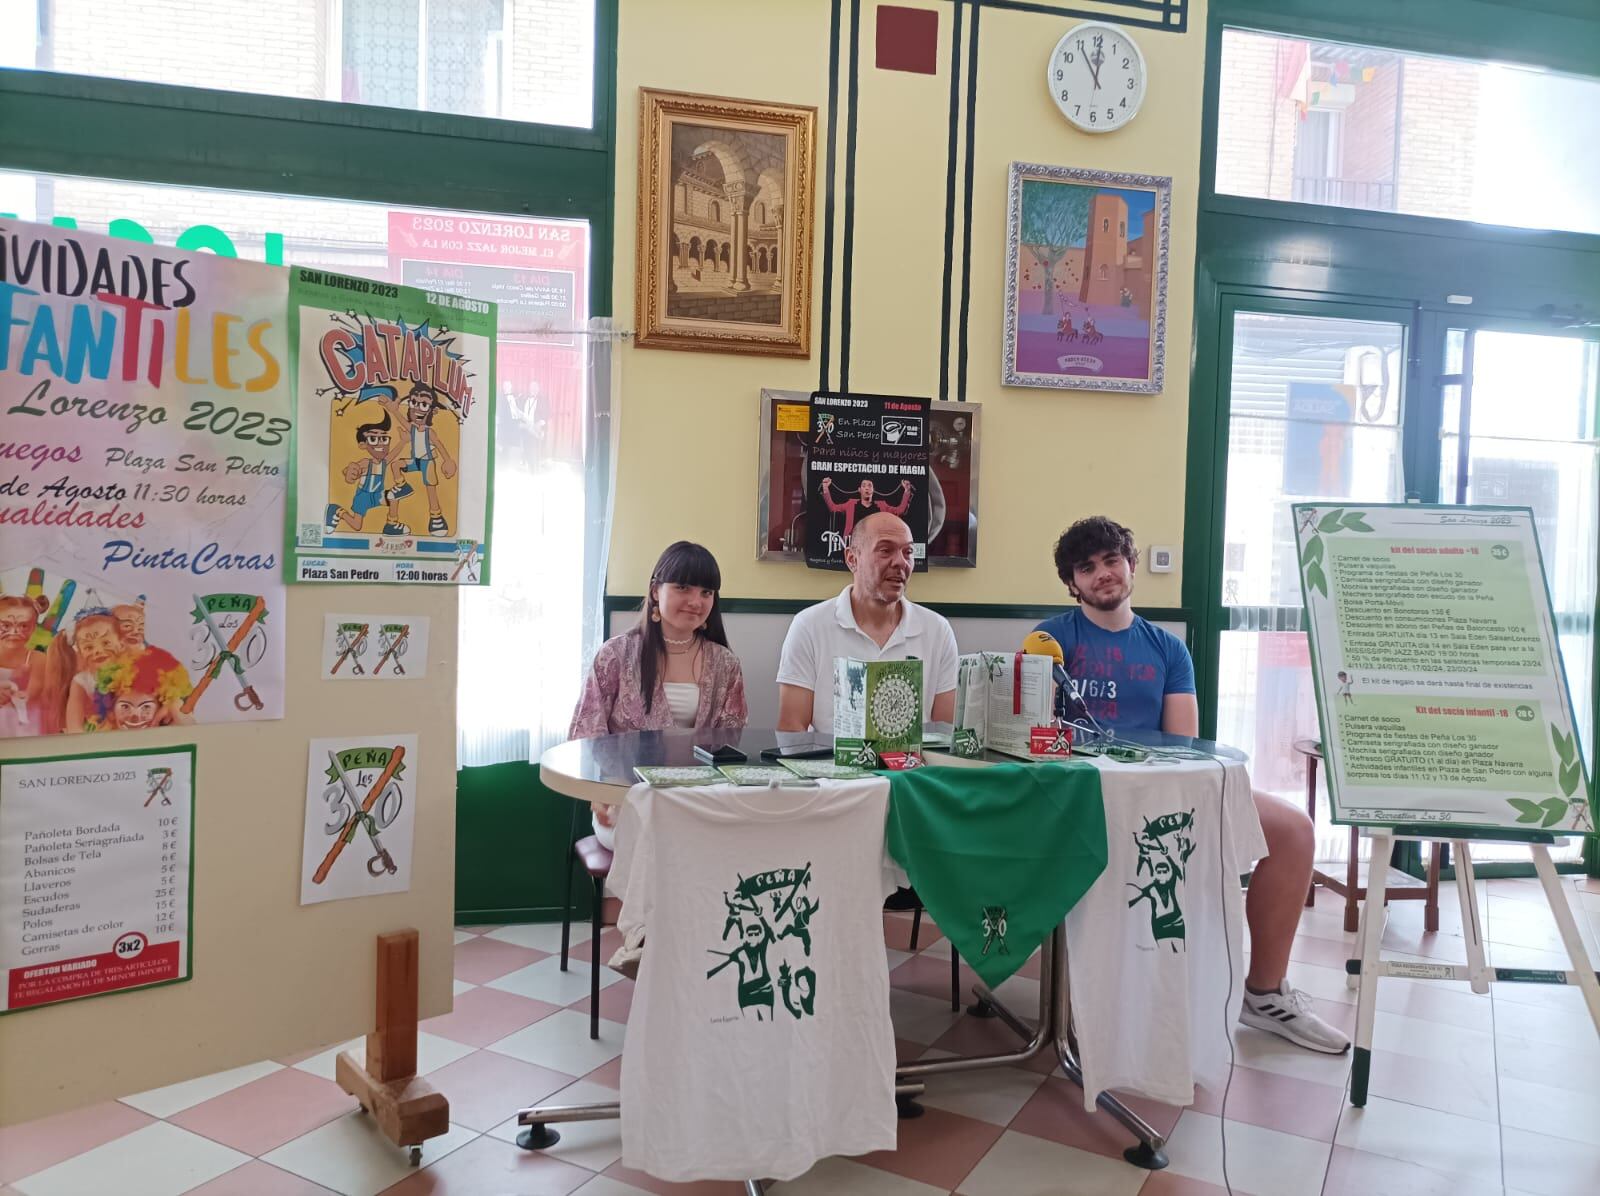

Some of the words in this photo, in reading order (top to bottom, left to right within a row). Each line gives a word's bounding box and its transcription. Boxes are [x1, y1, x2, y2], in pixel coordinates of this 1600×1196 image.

[1076, 40, 1084, 50] 11
[1093, 35, 1103, 48] 12
[1112, 44, 1116, 55] 1
[1063, 52, 1074, 63] 10
[1122, 58, 1130, 69] 2
[1056, 69, 1063, 81] 9
[1127, 78, 1134, 89] 3
[1061, 90, 1068, 101] 8
[1119, 97, 1126, 108] 4
[1074, 105, 1081, 116] 7
[1107, 109, 1114, 119] 5
[1090, 112, 1096, 123] 6
[0, 228, 196, 309] IVIDADES
[300, 270, 322, 285] SAN
[324, 273, 369, 292] LORENZO
[371, 283, 398, 298] 2023
[426, 293, 437, 304] 12
[438, 294, 450, 307] DE
[449, 297, 489, 314] AGOSTO
[319, 323, 473, 418] CATAPLUM
[814, 396, 826, 405] SAN
[827, 398, 851, 407] LORENZO
[852, 400, 868, 408] 2023
[7, 379, 168, 434] Lorenzo
[183, 401, 292, 446] 2023
[838, 418, 850, 426] En
[853, 418, 876, 427] Plaza
[836, 430, 855, 438] San
[857, 431, 879, 439] Pedro
[105, 447, 167, 475] Plaza
[175, 454, 217, 474] San
[225, 456, 280, 476] Pedro
[813, 447, 836, 456] Para
[840, 447, 869, 458] niños
[872, 451, 880, 463] y
[883, 451, 928, 464] mayores
[811, 461, 832, 471] GRAN
[833, 462, 887, 474] ESPECTACULO
[888, 464, 899, 474] DE
[899, 465, 926, 475] MAGIA
[37, 475, 127, 506] Agosto
[133, 483, 190, 502] 11:30
[196, 486, 247, 506] horas
[302, 568, 328, 579] Plaza
[330, 569, 348, 579] San
[350, 569, 379, 580] Pedro
[396, 571, 419, 580] 12:00
[421, 571, 448, 581] horas
[342, 749, 388, 768] PEÑA
[19, 778, 47, 789] SAN
[50, 773, 111, 786] LORENZO
[113, 771, 137, 781] 2023
[356, 770, 374, 788] Los
[158, 817, 170, 827] 10
[24, 828, 73, 841] Pañoleta
[76, 823, 121, 835] Bordada
[163, 830, 168, 839] 3
[24, 840, 72, 853] Pañoleta
[24, 854, 60, 866] Bolsas
[62, 852, 76, 862] de
[80, 849, 102, 860] Tela
[161, 853, 168, 862] 6
[24, 865, 76, 879] Abanicos
[161, 864, 168, 873] 5
[24, 878, 72, 892] Llaveros
[161, 877, 168, 886] 5
[23, 891, 70, 905] Escudos
[155, 888, 167, 898] 25
[22, 902, 81, 918] Sudaderas
[156, 900, 167, 910] 15
[156, 912, 167, 922] 12
[22, 918, 53, 930] Polos
[155, 924, 167, 934] 10
[22, 926, 79, 943] Camisetas
[81, 924, 95, 934] de
[97, 920, 125, 931] color
[21, 943, 61, 956] Gorras
[118, 939, 141, 954] 3x2
[62, 959, 97, 973] VARIADO
